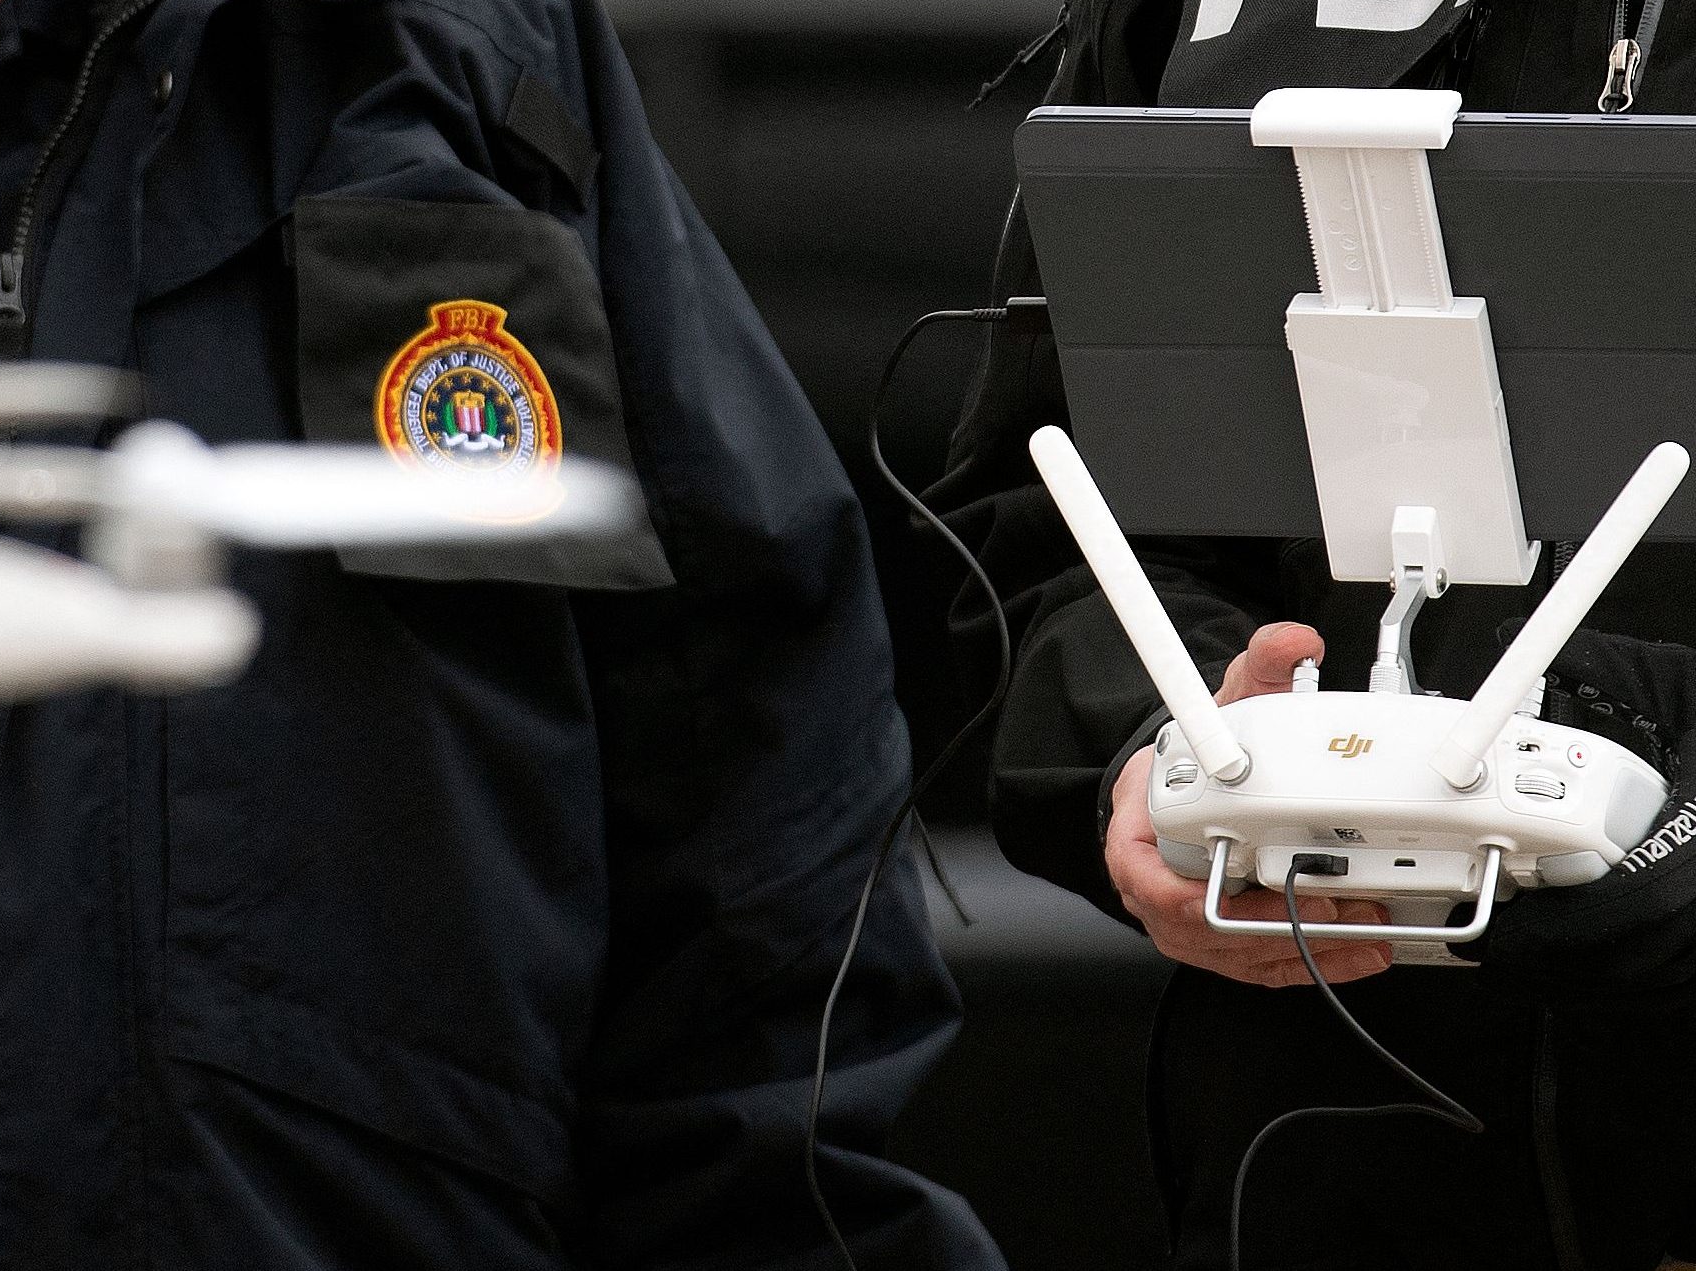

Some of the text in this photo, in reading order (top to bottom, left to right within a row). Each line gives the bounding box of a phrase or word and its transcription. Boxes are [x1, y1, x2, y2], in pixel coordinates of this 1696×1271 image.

[448, 309, 489, 331] FBI
[450, 351, 468, 368] OF
[471, 351, 520, 396] JUSTICE
[407, 391, 430, 453] FEDERAL
